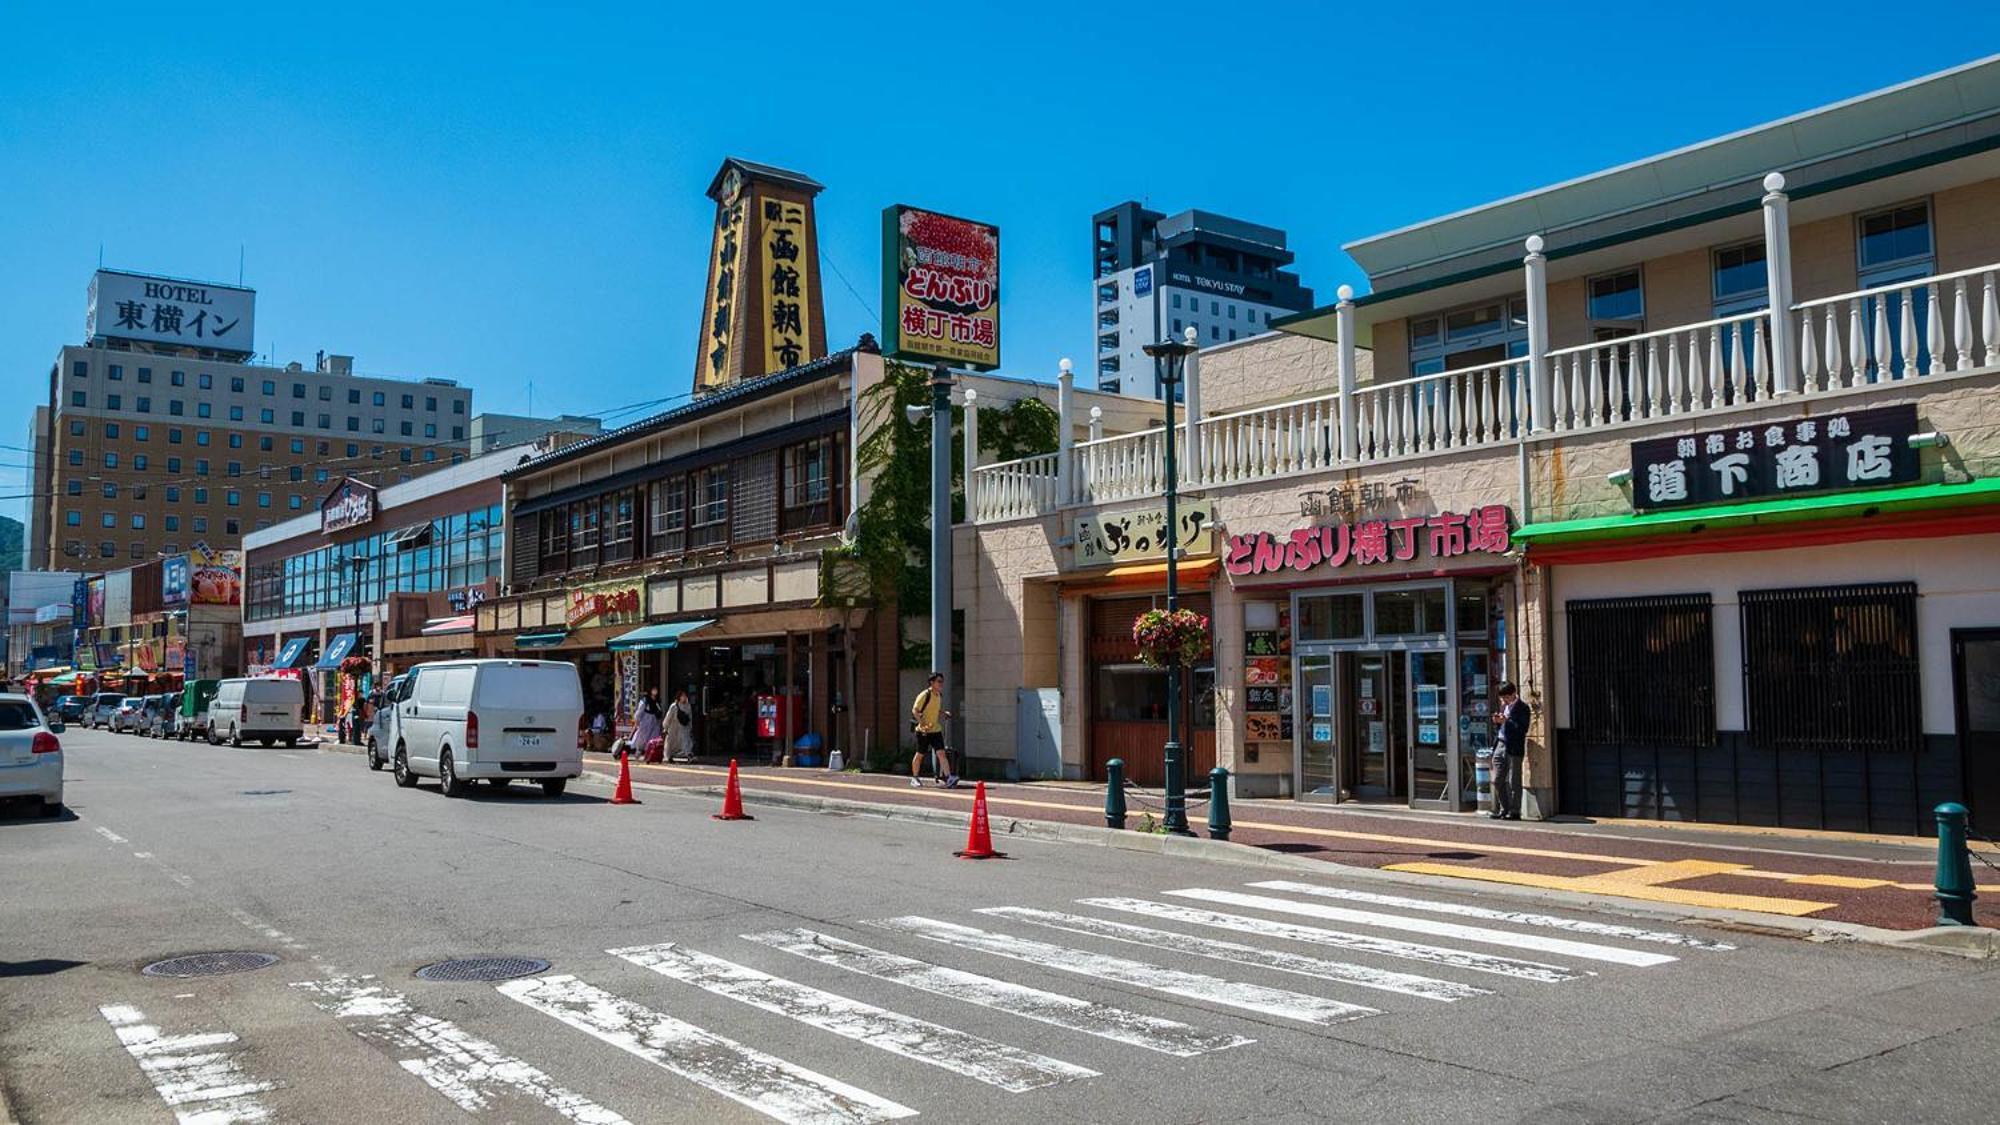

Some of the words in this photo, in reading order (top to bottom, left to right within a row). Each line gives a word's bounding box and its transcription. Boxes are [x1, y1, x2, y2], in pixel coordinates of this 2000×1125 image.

[144, 282, 213, 305] HOTEL
[770, 228, 803, 371] 函館朝市
[904, 267, 993, 310] どんぶり
[1172, 272, 1191, 284] HOTEL
[1195, 276, 1224, 292] TOKYU
[1224, 282, 1246, 297] STAY
[114, 300, 240, 338] 東横イン
[903, 305, 996, 347] 横丁市場
[1676, 416, 1851, 459] 朝市お食事処
[1648, 434, 1893, 502] 道下商店
[1298, 477, 1420, 517] 函館朝市
[1226, 504, 1510, 575] どんぶり横丁市場
